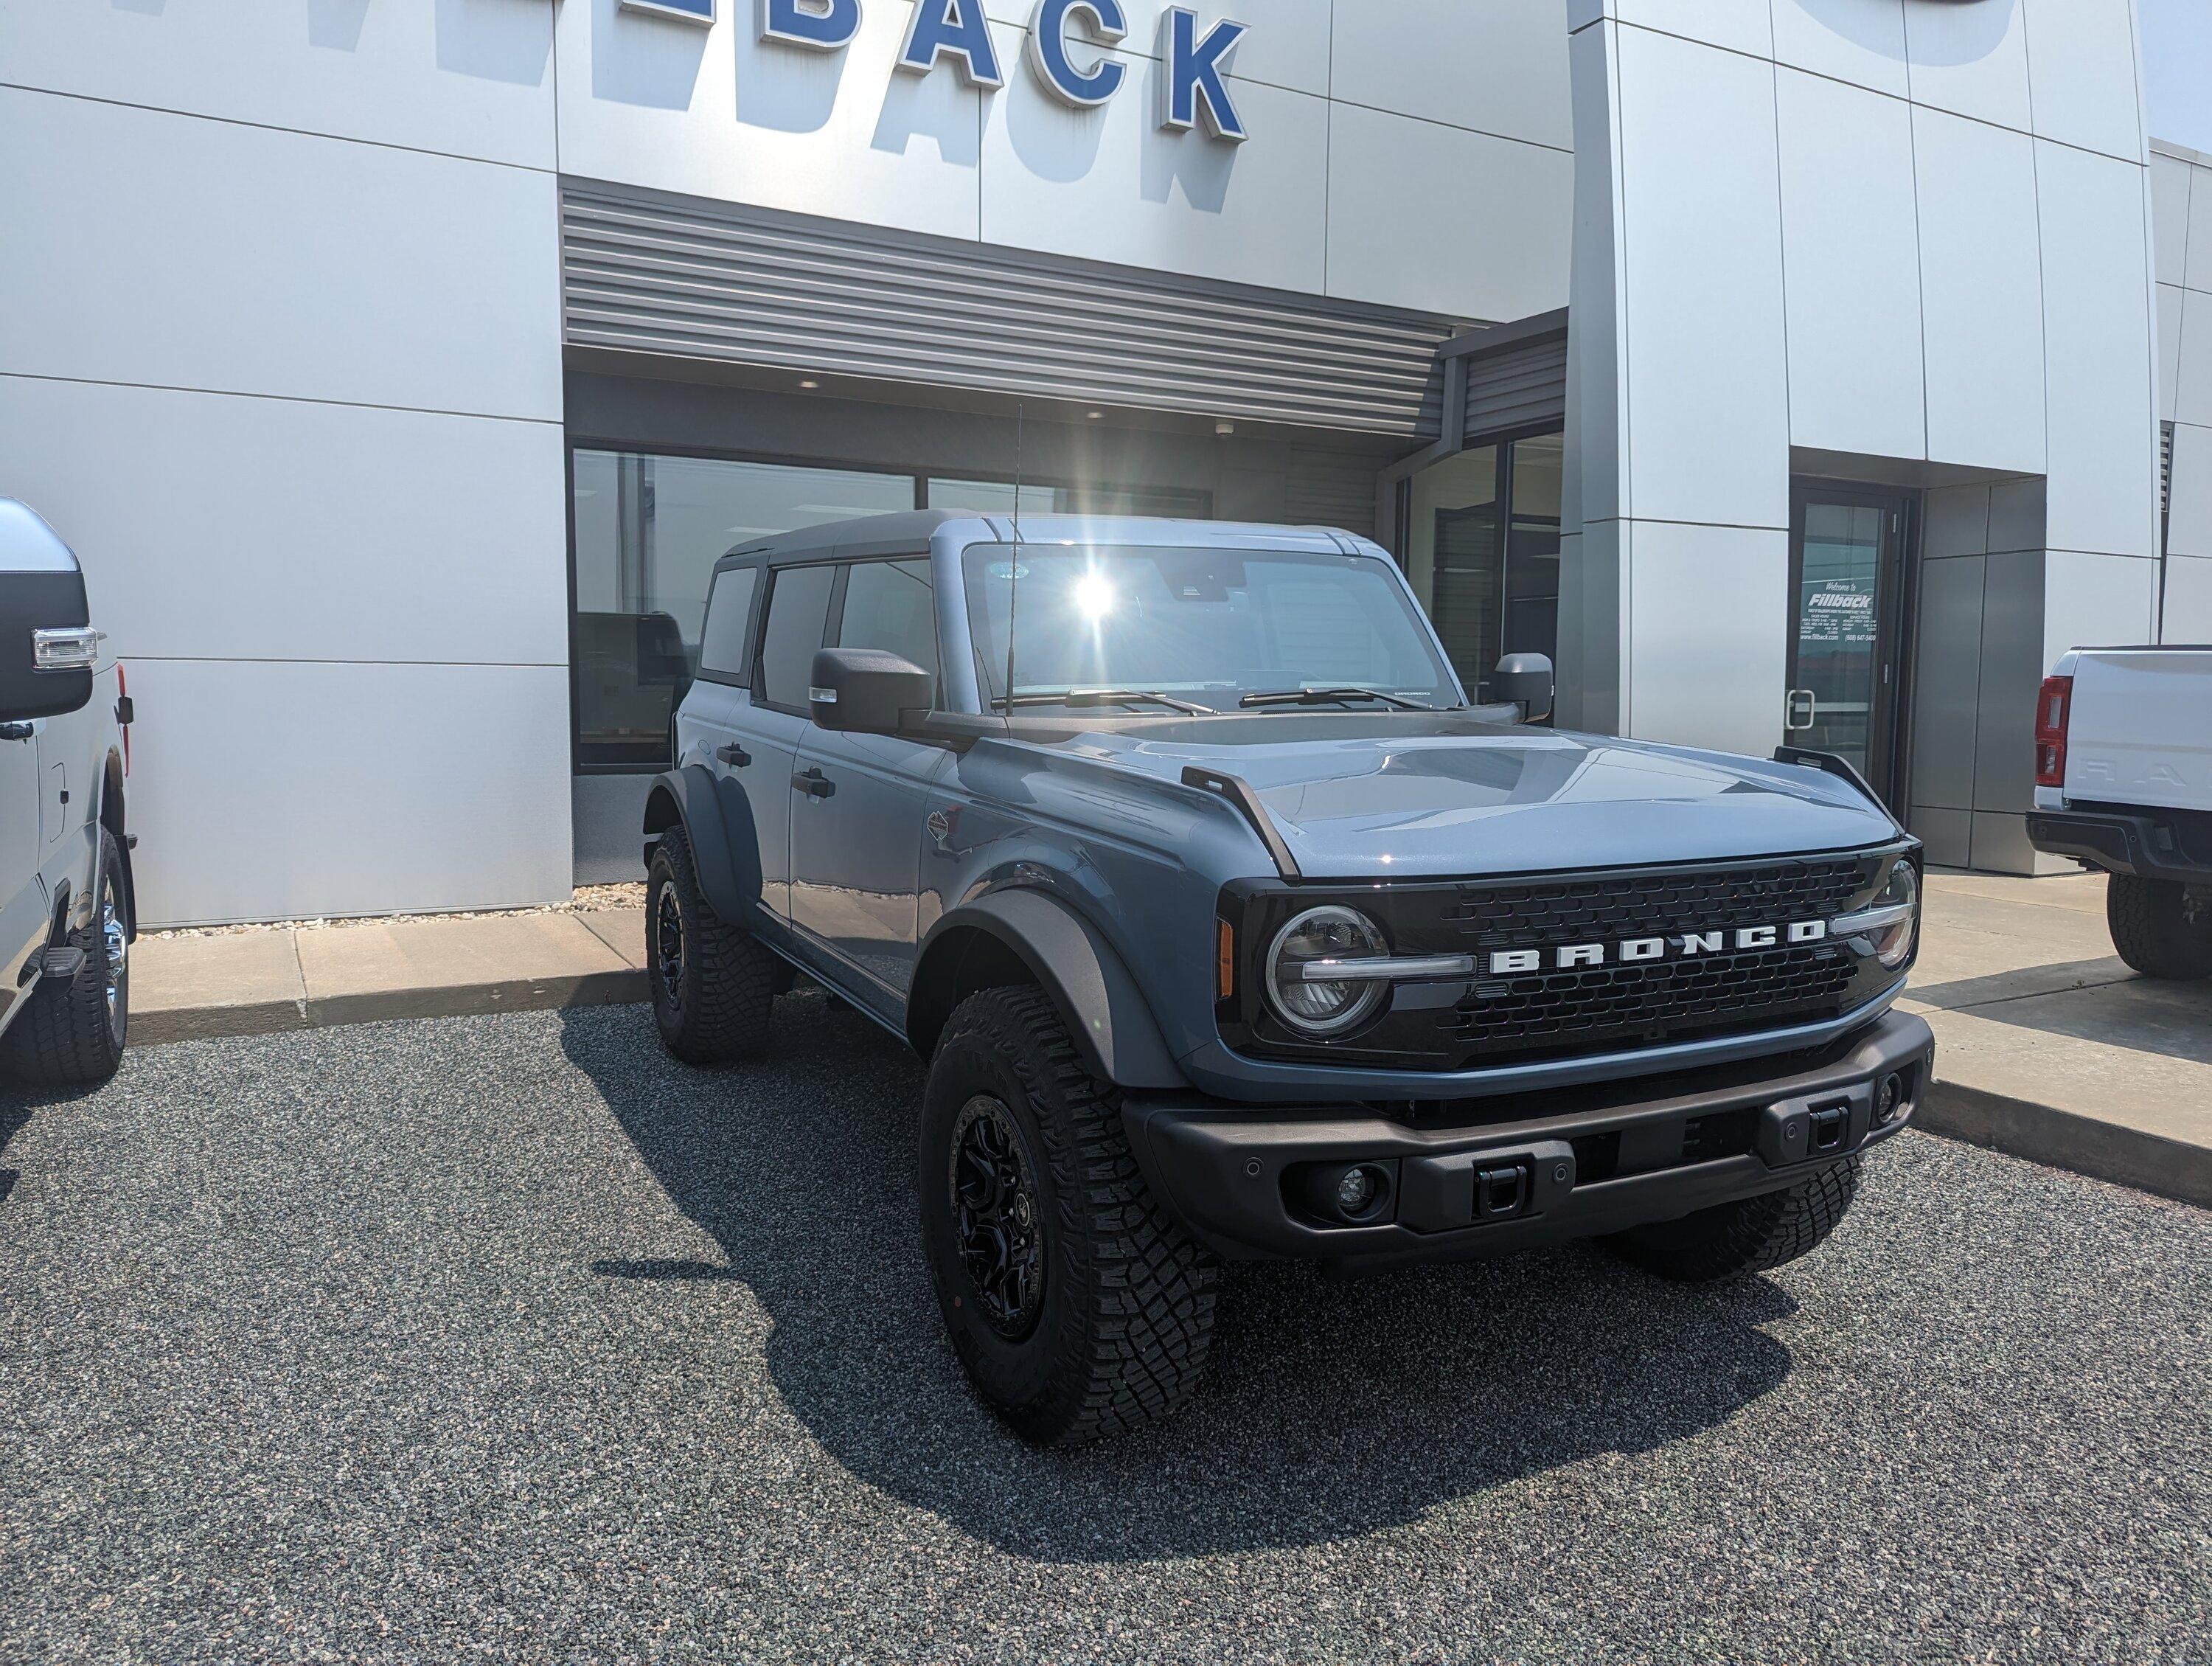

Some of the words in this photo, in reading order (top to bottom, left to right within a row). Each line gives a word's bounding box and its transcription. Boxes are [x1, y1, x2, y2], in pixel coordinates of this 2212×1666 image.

[1826, 581, 1850, 591] Welcome
[1808, 594, 1871, 607] Fillback
[1490, 920, 1825, 973] BRONCO
